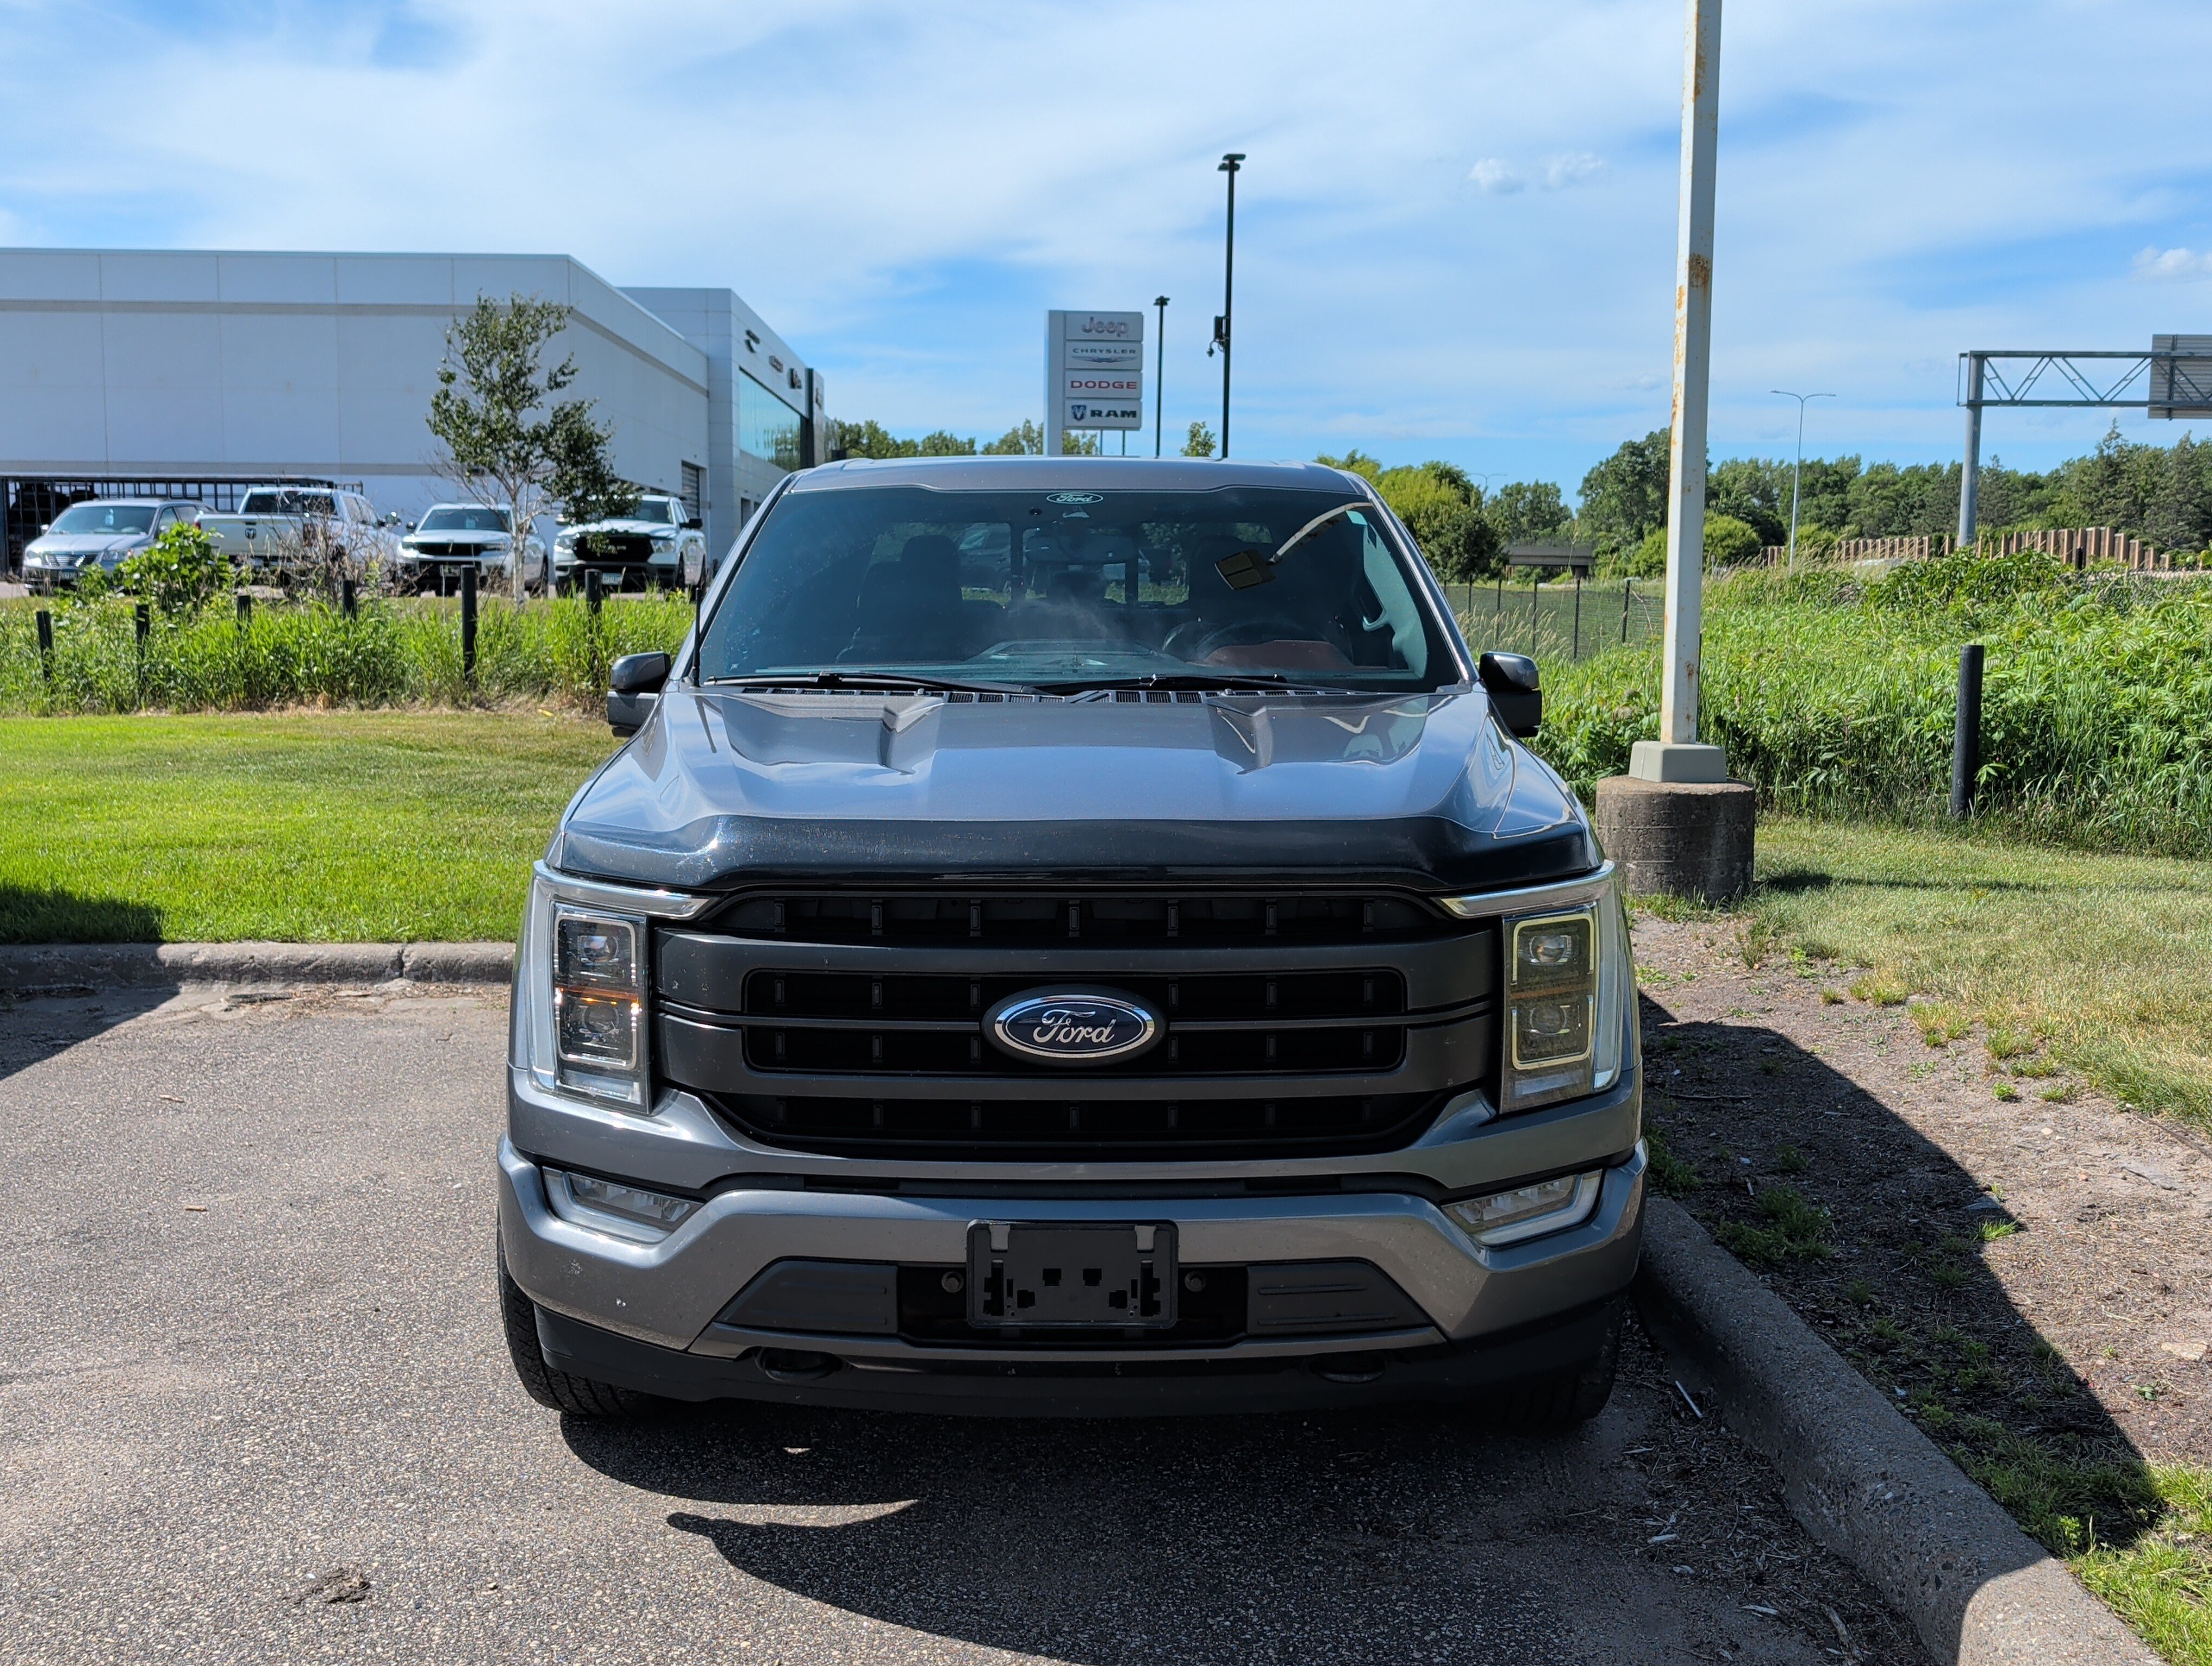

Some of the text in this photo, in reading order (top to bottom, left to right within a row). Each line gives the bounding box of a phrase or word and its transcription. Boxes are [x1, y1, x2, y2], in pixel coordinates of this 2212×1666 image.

[1082, 317, 1130, 337] Jeep
[1071, 381, 1137, 389] DODGE
[1090, 410, 1137, 418] RAM
[1033, 1009, 1116, 1043] Ford
